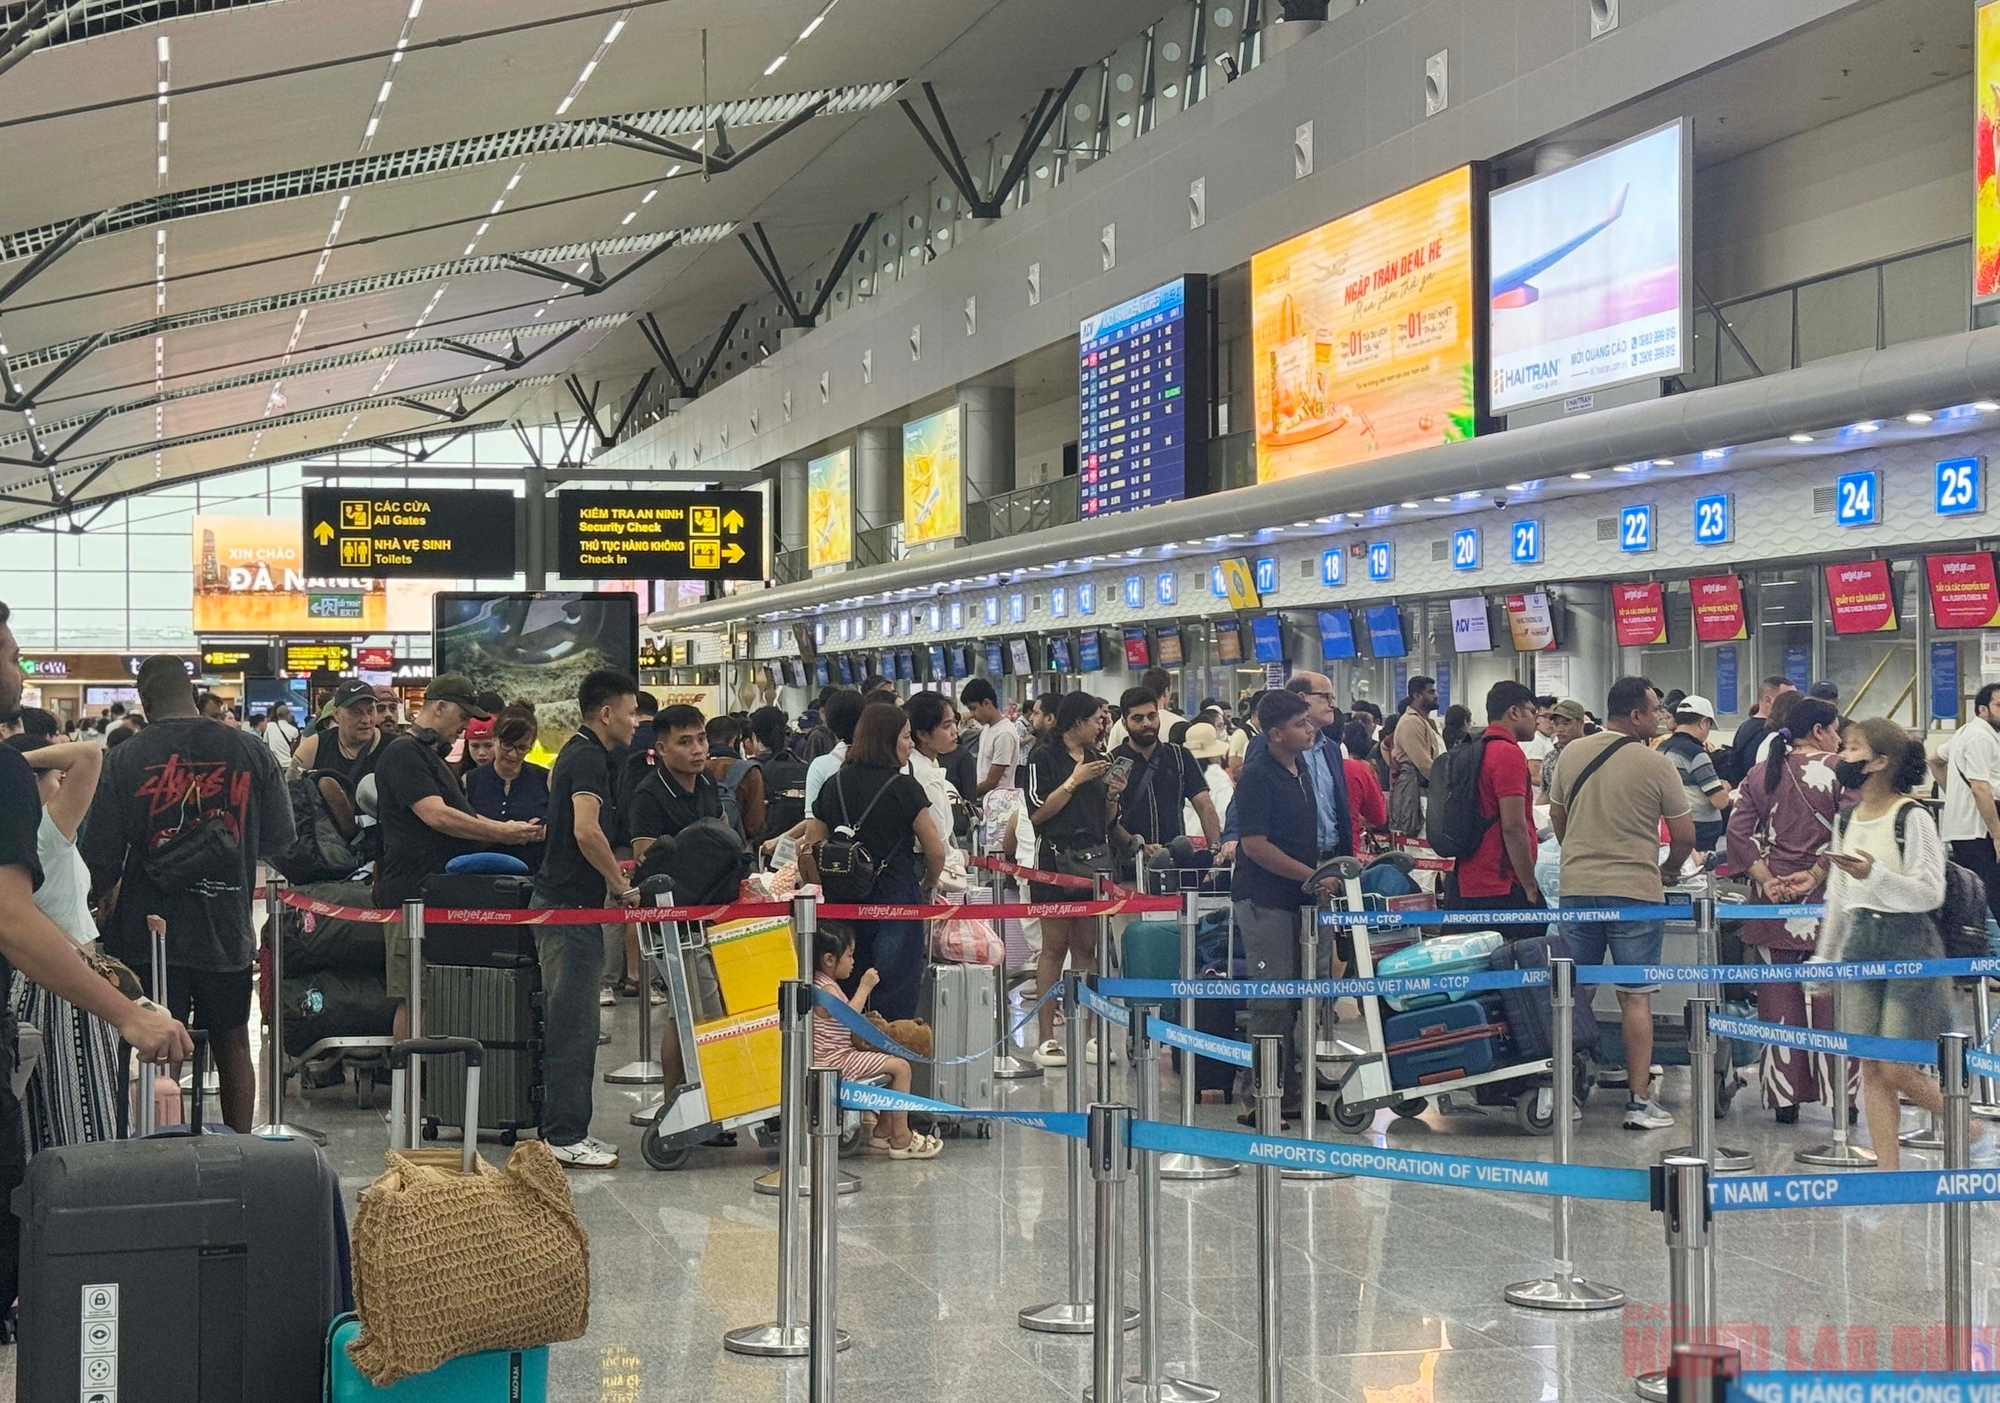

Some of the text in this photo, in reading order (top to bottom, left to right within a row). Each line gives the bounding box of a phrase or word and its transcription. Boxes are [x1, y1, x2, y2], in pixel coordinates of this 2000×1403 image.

[1400, 247, 1425, 278] DEAL
[1408, 310, 1420, 339] 01
[1350, 330, 1362, 356] 01
[1942, 468, 1972, 505] 25
[374, 500, 431, 512] CÁC CỬA
[1842, 480, 1870, 516] 24
[374, 515, 426, 526] All Gates
[611, 509, 634, 520] TRA
[636, 509, 654, 520] AN
[656, 509, 684, 520] NINH
[1700, 504, 1723, 537] 23
[579, 522, 662, 534] Security Check
[1624, 514, 1648, 545] 22
[374, 537, 452, 553] NHÀ VỆ SINH
[600, 541, 620, 554] TỤC
[622, 539, 650, 551] HÀNG
[650, 539, 685, 552] KHÔNG
[1457, 533, 1474, 564] 20
[1516, 526, 1534, 557] 21
[229, 548, 296, 560] XIN CHÀO
[374, 554, 413, 564] Toilets
[580, 554, 628, 564] Check in
[1373, 547, 1387, 575] 19
[228, 562, 274, 591] ĐÀ
[1260, 564, 1272, 590] 17
[1326, 554, 1339, 580] 18
[1128, 582, 1138, 603] 14
[1160, 576, 1171, 597] 15
[340, 609, 360, 617] EXIT
[1054, 593, 1064, 612] 12
[1456, 618, 1470, 632] ACV
[1346, 914, 1368, 924] NAM
[1376, 914, 1402, 924] CTCP
[1443, 910, 1620, 924] AIRPORTS CORPORATION OF VIETNAM
[1712, 968, 1724, 980] TY
[1862, 964, 1886, 976] NAM
[1894, 962, 1922, 975] CTCP
[1206, 980, 1240, 995] CÔNG
[1244, 984, 1258, 994] TY
[1334, 979, 1374, 994] KHÔNG
[1405, 978, 1430, 990] NAM
[1440, 976, 1470, 988] CTCP
[1738, 1023, 1795, 1044] CORPORATION
[1796, 1034, 1807, 1044] OF
[1808, 1034, 1848, 1050] VIETNAM
[1250, 1142, 1548, 1186] AIRPORTS CORPORATION OF VIETNAM
[1724, 1181, 1768, 1204] NAM
[1786, 1179, 1838, 1202] CTCP
[1936, 1174, 2000, 1196] AIRPO
[1790, 1378, 1864, 1403] HÀNG
[1870, 1378, 1962, 1403] KHÔNG
